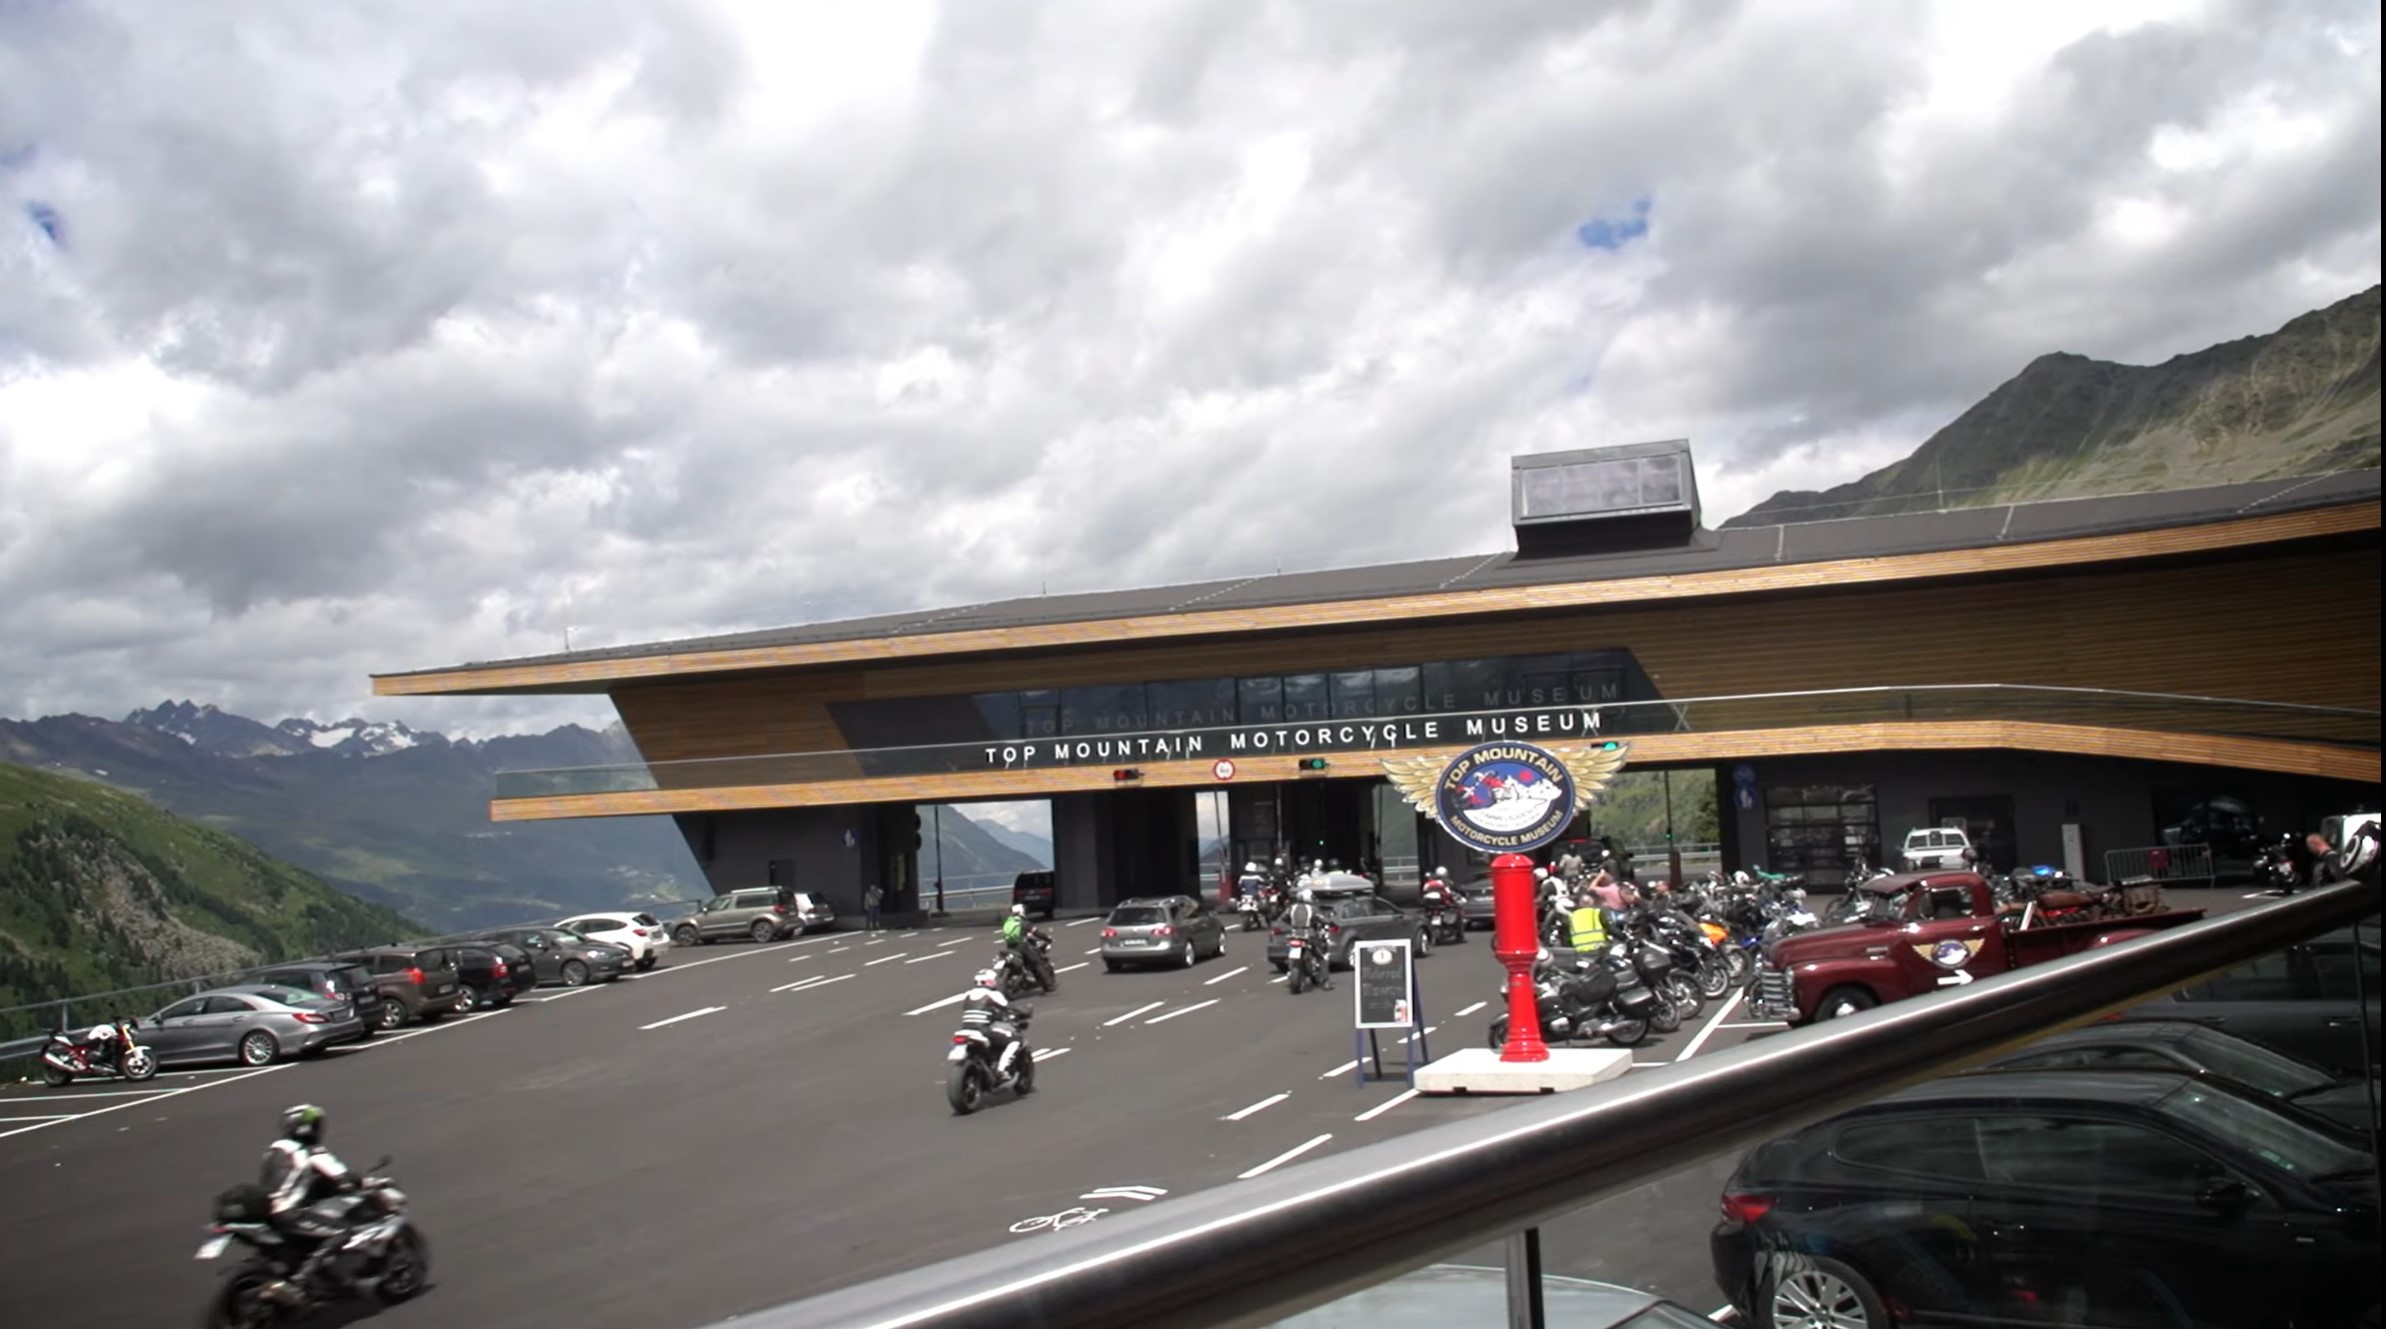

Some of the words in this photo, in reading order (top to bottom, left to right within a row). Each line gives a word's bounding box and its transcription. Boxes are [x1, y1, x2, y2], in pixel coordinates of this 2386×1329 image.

[1026, 717, 1073, 735] TOP
[1096, 708, 1235, 730] MOUNTAIN
[1260, 694, 1455, 719] MOTORCYCLE
[1484, 684, 1617, 706] MUSEUM
[985, 746, 1036, 763] TOP
[1055, 736, 1202, 759] MOUNTAIN
[1231, 722, 1438, 749] MOTORCYCLE
[1467, 712, 1600, 735] MUSEUM
[1445, 760, 1471, 789] TOP
[1475, 748, 1562, 783] MOUNTAIN
[1450, 816, 1518, 845] MOTORCYCLE
[1521, 810, 1563, 842] MUSEUM
